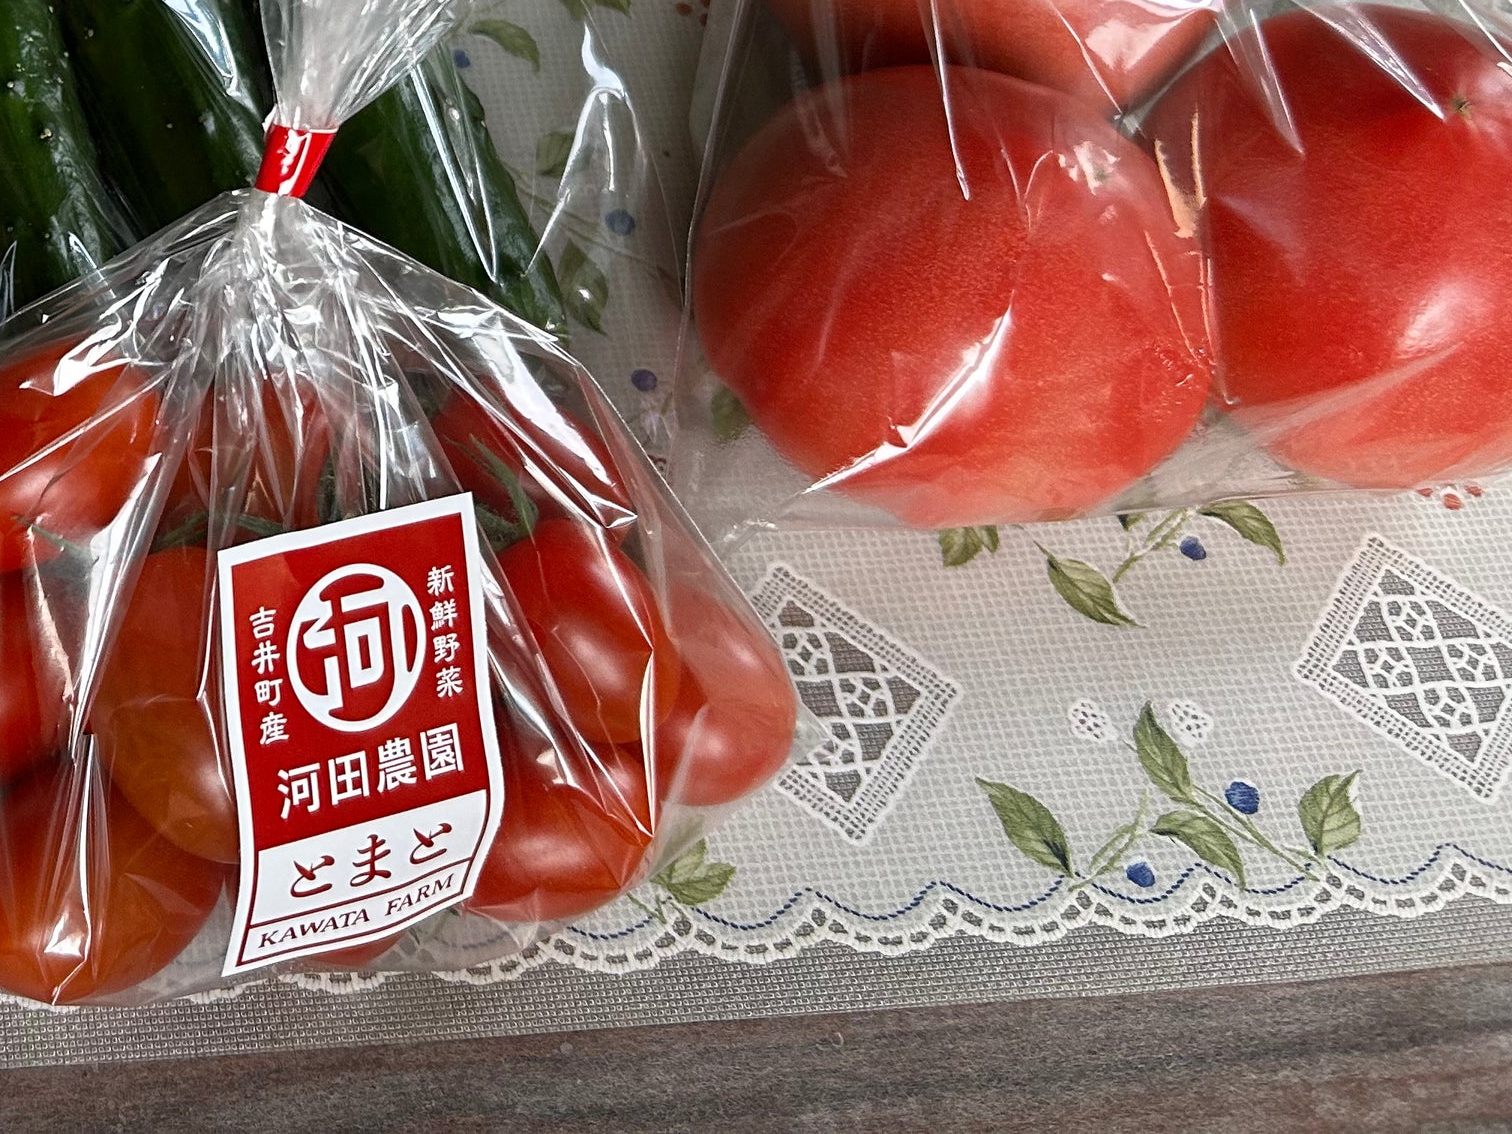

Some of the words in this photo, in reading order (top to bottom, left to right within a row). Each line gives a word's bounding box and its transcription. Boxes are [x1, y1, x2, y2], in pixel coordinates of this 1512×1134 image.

[249, 605, 290, 746] 吉井町産
[427, 564, 464, 699] 新鮮野菜
[278, 722, 464, 820] 河田農園
[290, 822, 451, 898] とまと
[258, 908, 370, 948] KAWATA
[384, 873, 455, 917] FARM
